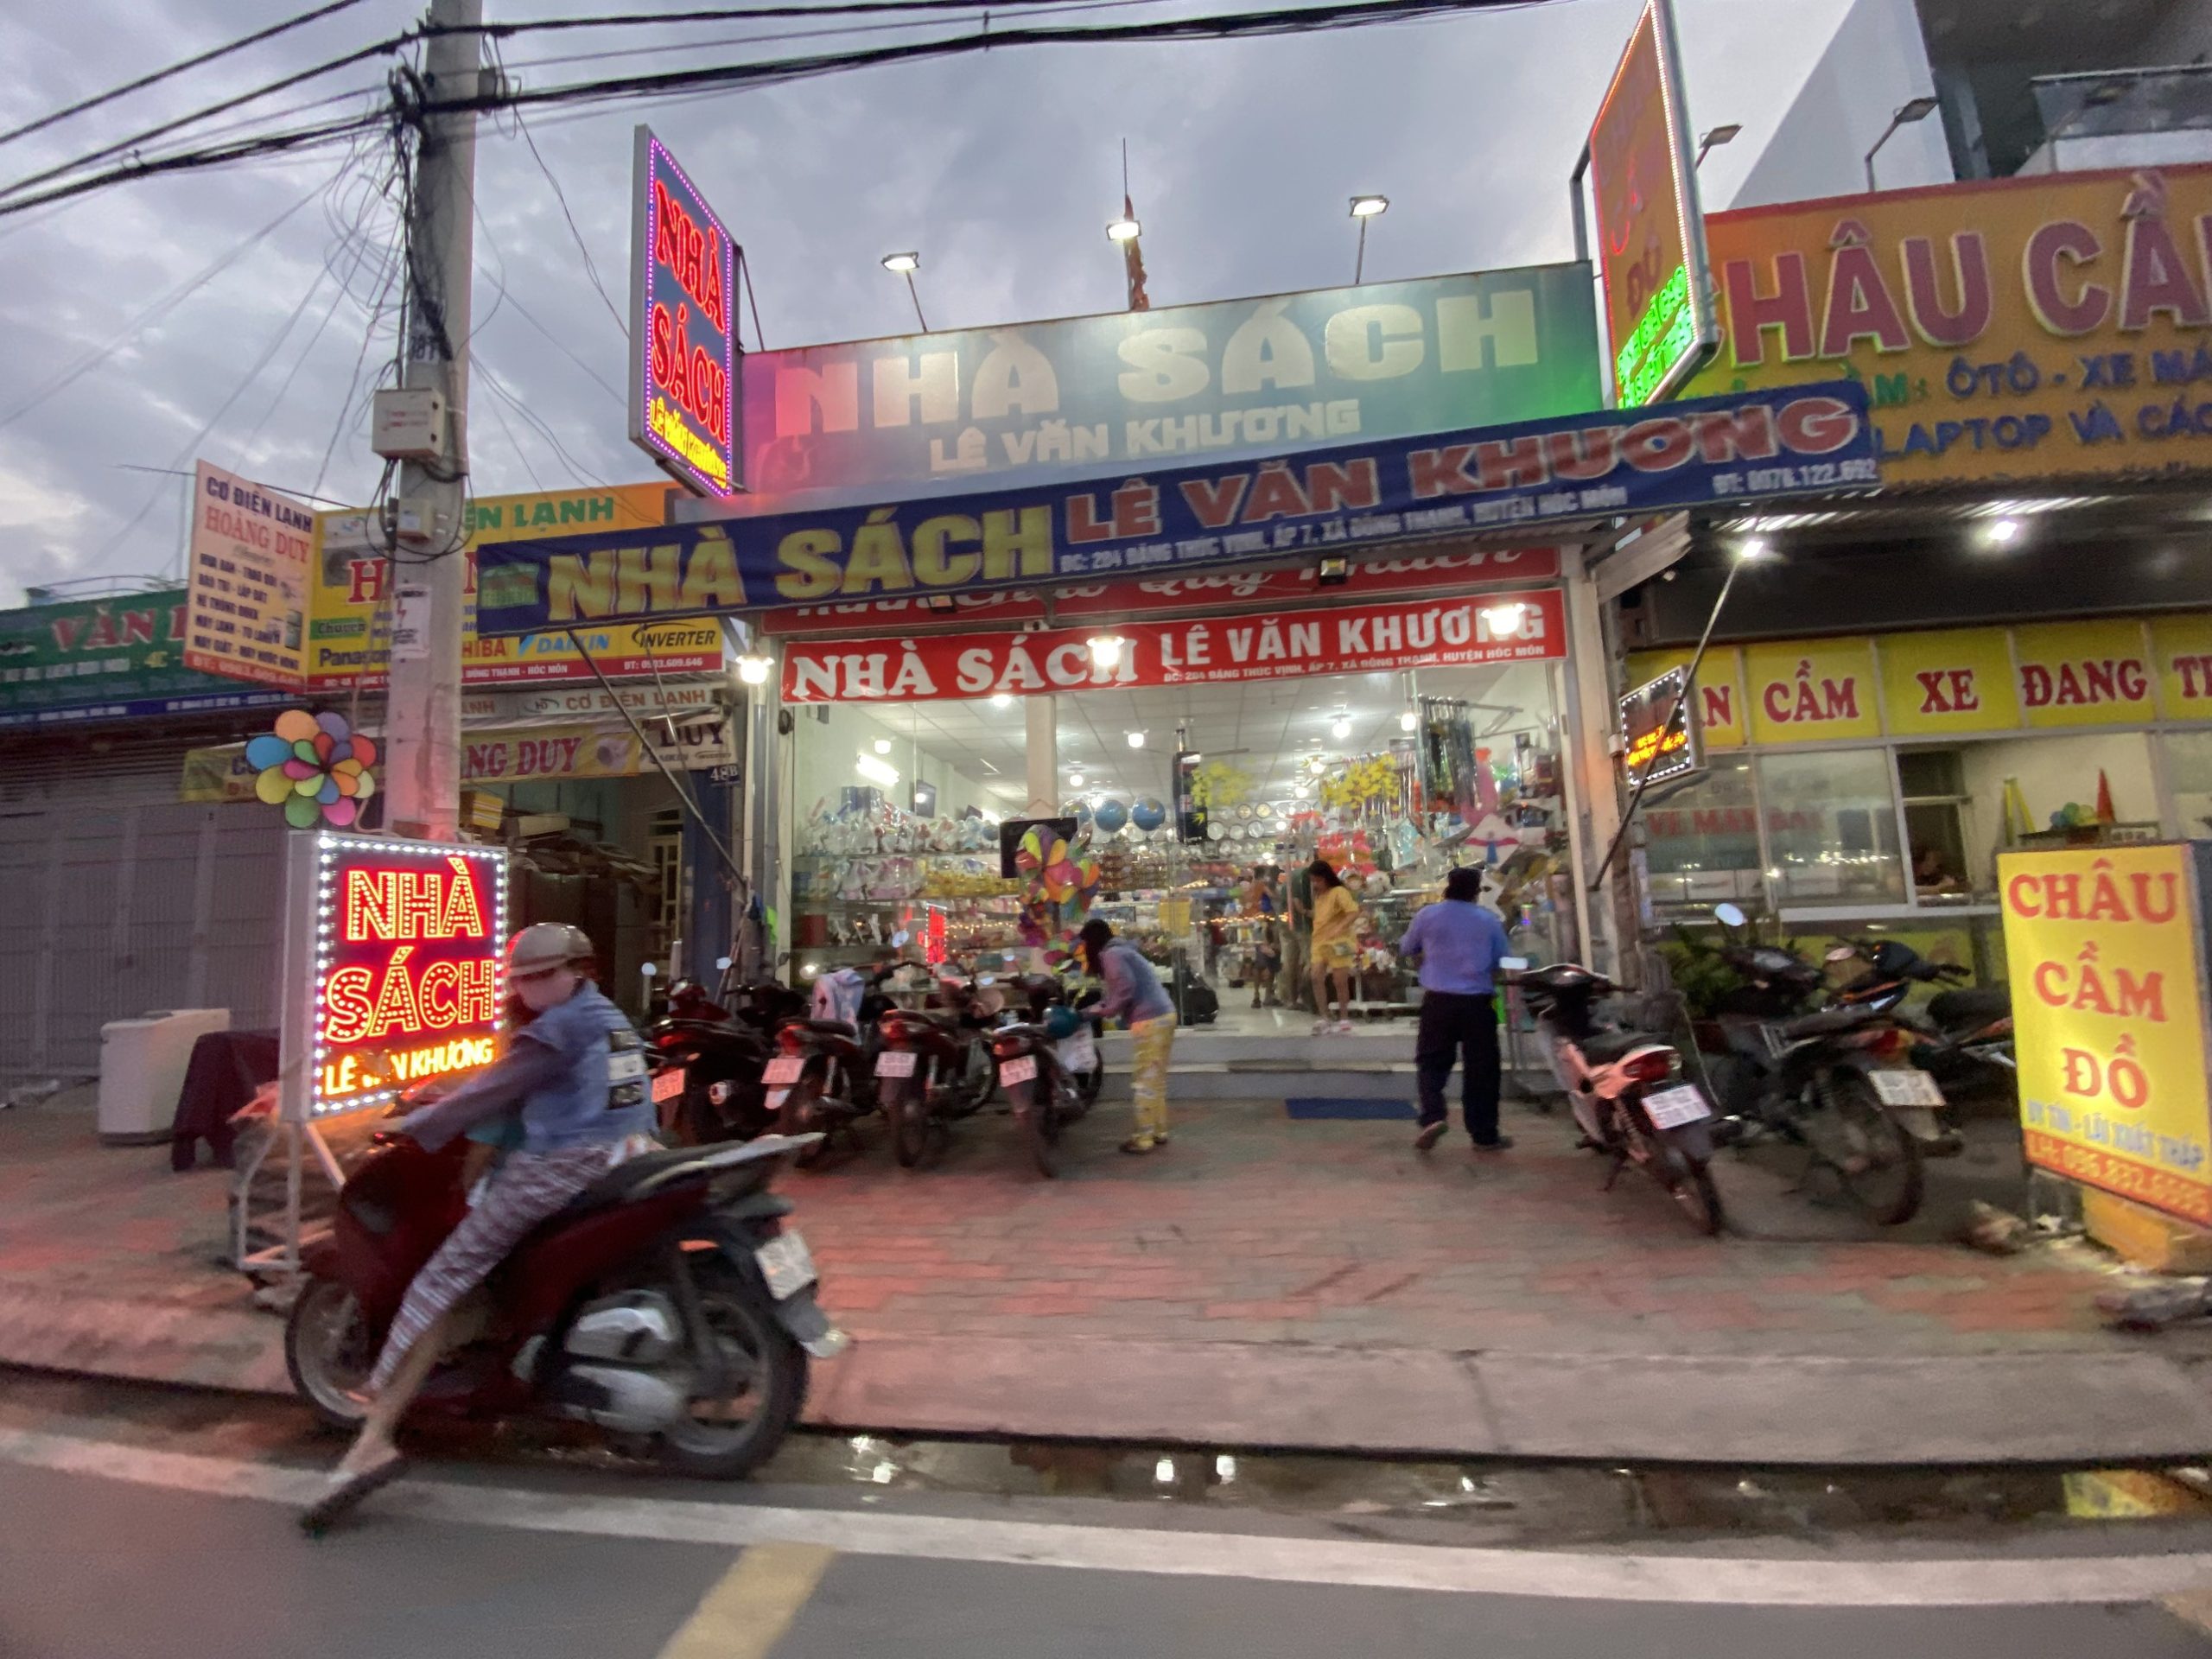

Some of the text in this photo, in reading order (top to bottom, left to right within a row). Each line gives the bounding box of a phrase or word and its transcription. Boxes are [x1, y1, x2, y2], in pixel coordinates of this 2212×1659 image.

[655, 179, 726, 335] NHÀ
[1709, 218, 1992, 370] HÂU
[652, 302, 727, 447] SÁCH
[775, 332, 1060, 437] NHÀ
[1118, 289, 1539, 403] SÁCH
[2078, 353, 2135, 389] XE
[930, 397, 1361, 472] LÊ VĂN KHƯƠNG
[514, 497, 614, 532] LẠNH
[547, 524, 747, 622] NHÀ
[775, 505, 1054, 602] SÁCH
[1065, 476, 1162, 545] LÊ
[1177, 456, 1381, 529] VĂN
[1408, 396, 1859, 500] KHƯƠNG
[791, 639, 938, 697] NHÀ
[1161, 624, 1211, 666] LÊ
[1226, 618, 1321, 661] VĂN
[1763, 658, 1859, 723] CẦM
[1916, 668, 1980, 714] XE
[2019, 658, 2147, 707] ĐANG
[516, 736, 582, 776] DUY
[346, 856, 484, 940] NHÀ
[2007, 857, 2179, 925] CHÂU
[324, 945, 495, 1043] SÁCH
[2034, 940, 2168, 1023] CẦM
[324, 1055, 358, 1096] LÊ
[2061, 1033, 2149, 1109] ĐỒ
